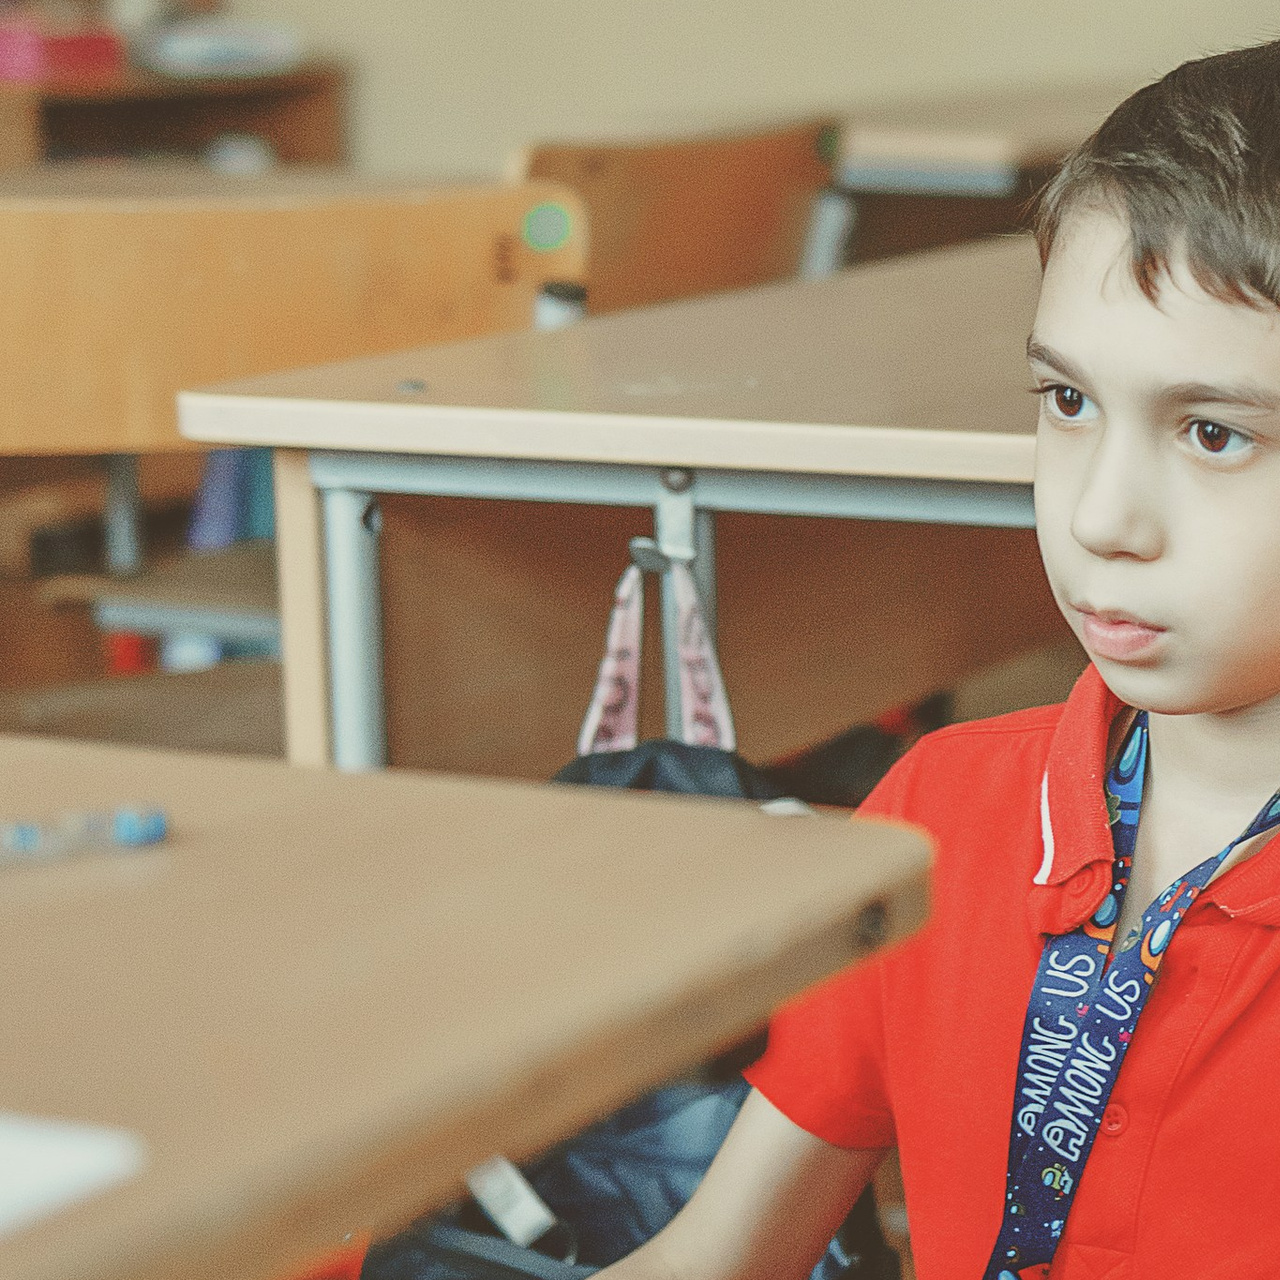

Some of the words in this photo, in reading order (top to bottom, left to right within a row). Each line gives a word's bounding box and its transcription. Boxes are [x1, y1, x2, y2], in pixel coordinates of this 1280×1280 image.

[1041, 950, 1095, 998] US
[1042, 1032, 1116, 1162] AMONG
[1095, 970, 1140, 1021] US
